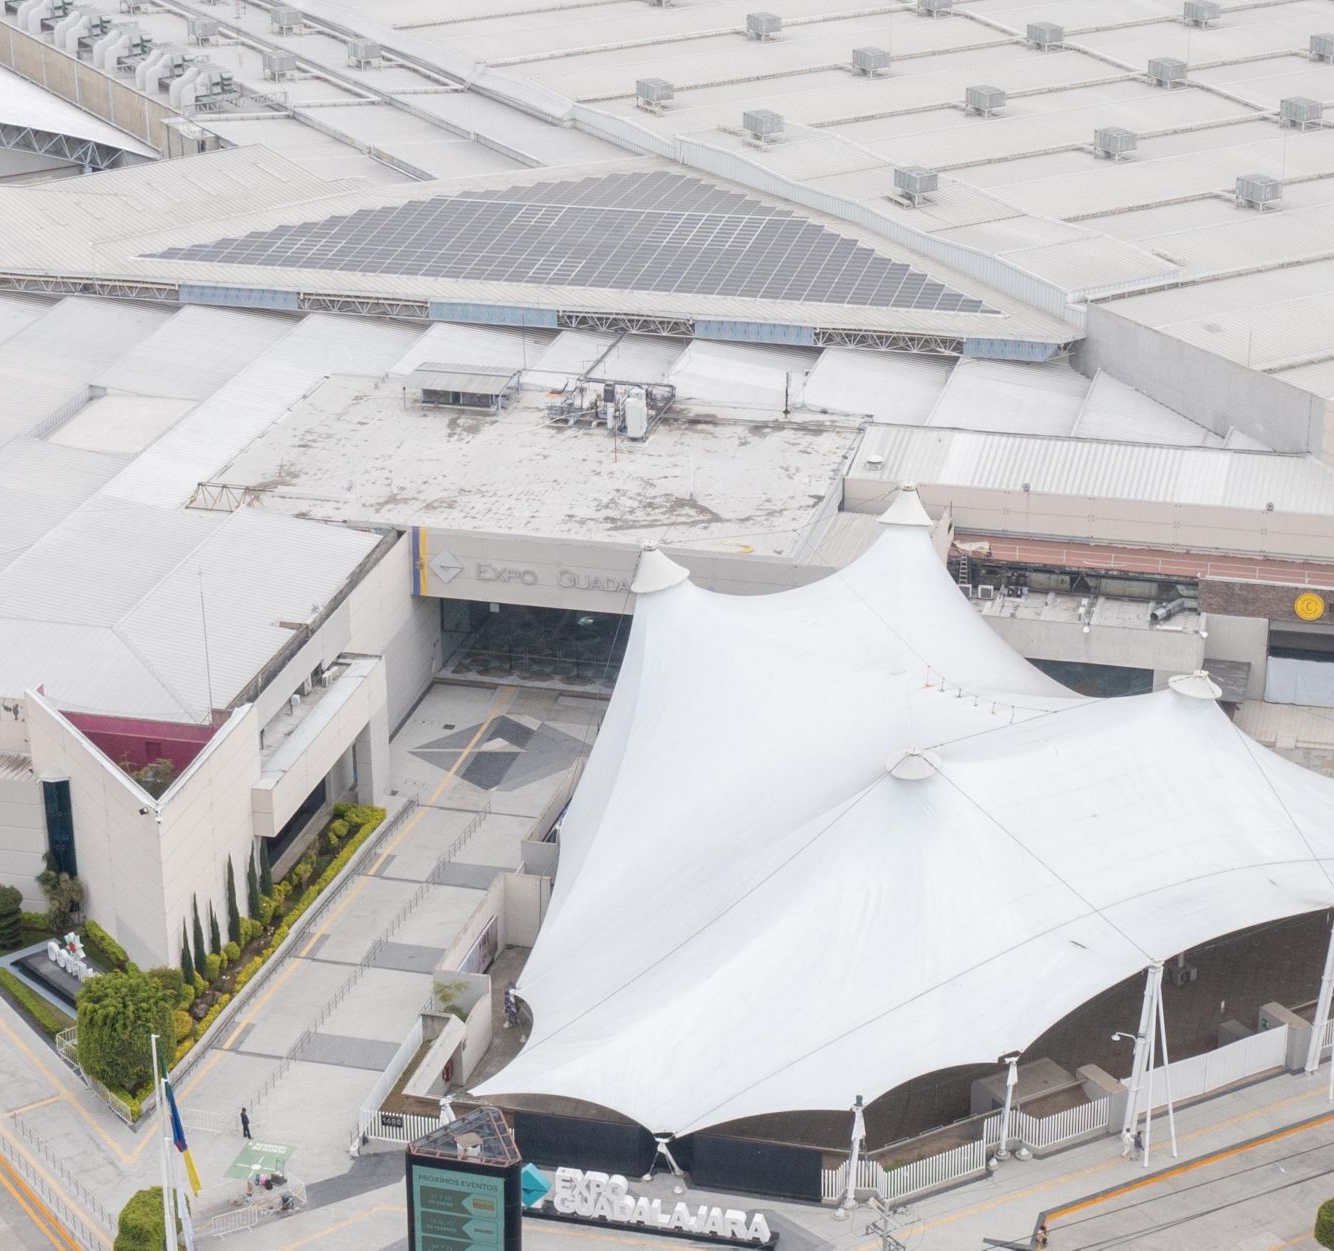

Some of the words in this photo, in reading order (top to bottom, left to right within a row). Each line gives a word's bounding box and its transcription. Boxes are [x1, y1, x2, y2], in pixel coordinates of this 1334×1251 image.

[461, 1179, 499, 1193] EVENTOS
[554, 1166, 629, 1201] EXPO
[553, 1192, 771, 1242] GUADALAJARA
